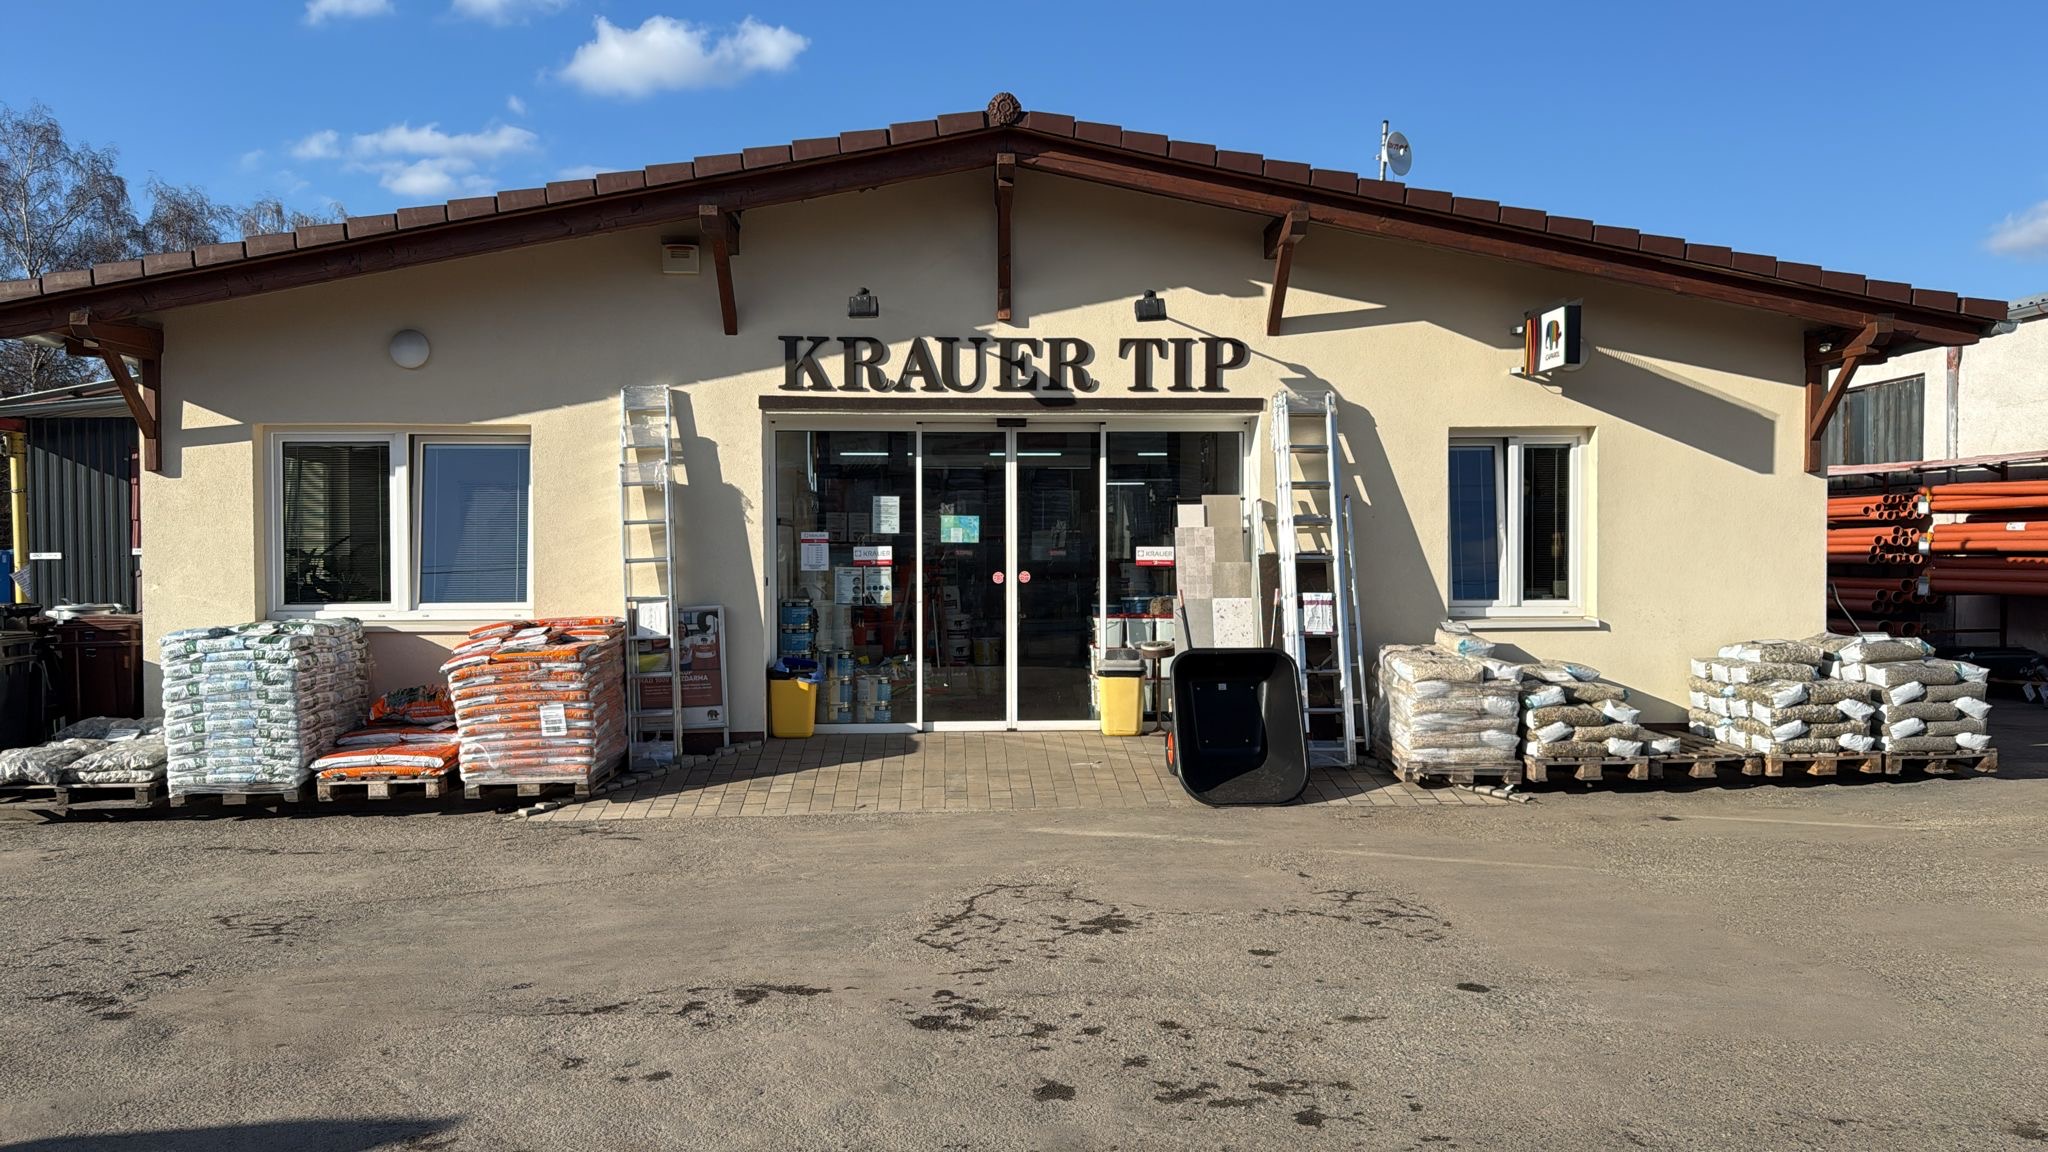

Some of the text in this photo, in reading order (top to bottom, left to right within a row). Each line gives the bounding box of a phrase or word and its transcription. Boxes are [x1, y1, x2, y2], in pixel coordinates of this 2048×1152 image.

[778, 335, 1249, 393] KRAUER TIP
[863, 549, 891, 557] KRAUER
[1145, 550, 1173, 558] KRAUER
